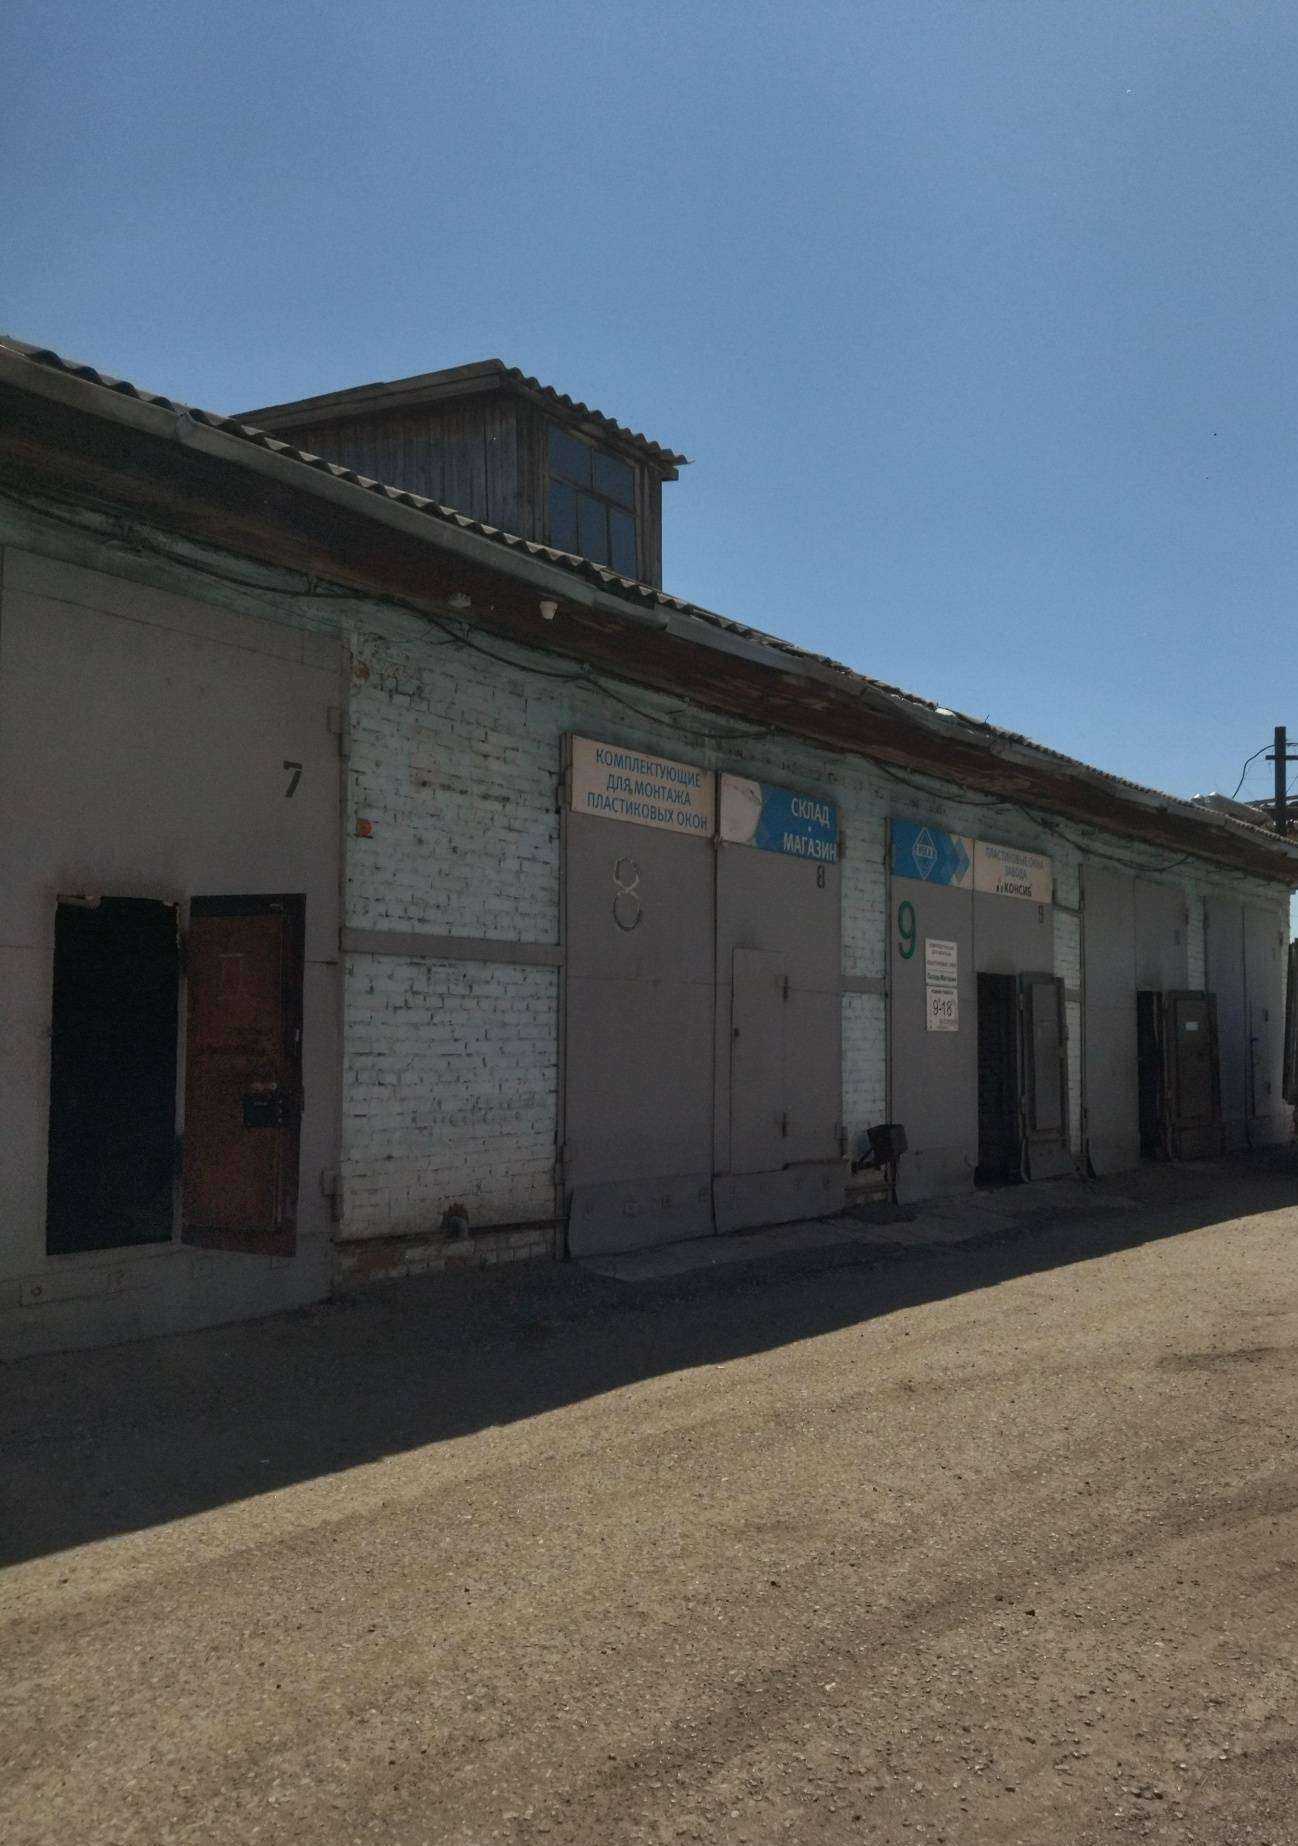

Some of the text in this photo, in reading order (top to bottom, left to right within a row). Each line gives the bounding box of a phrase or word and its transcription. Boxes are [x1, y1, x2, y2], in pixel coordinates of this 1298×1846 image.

[282, 761, 304, 798] 7
[595, 748, 702, 788] КОМПЛЕКТУЮЩИЕ
[606, 773, 692, 807] ДЛЯ МОНТАЖА
[587, 791, 708, 831] ПЛАСТИКОВЫХ ОКОН
[791, 797, 830, 826] СКЛАД
[783, 831, 838, 861] МАГАЗИН
[612, 856, 643, 932] 8
[897, 900, 917, 960] 9
